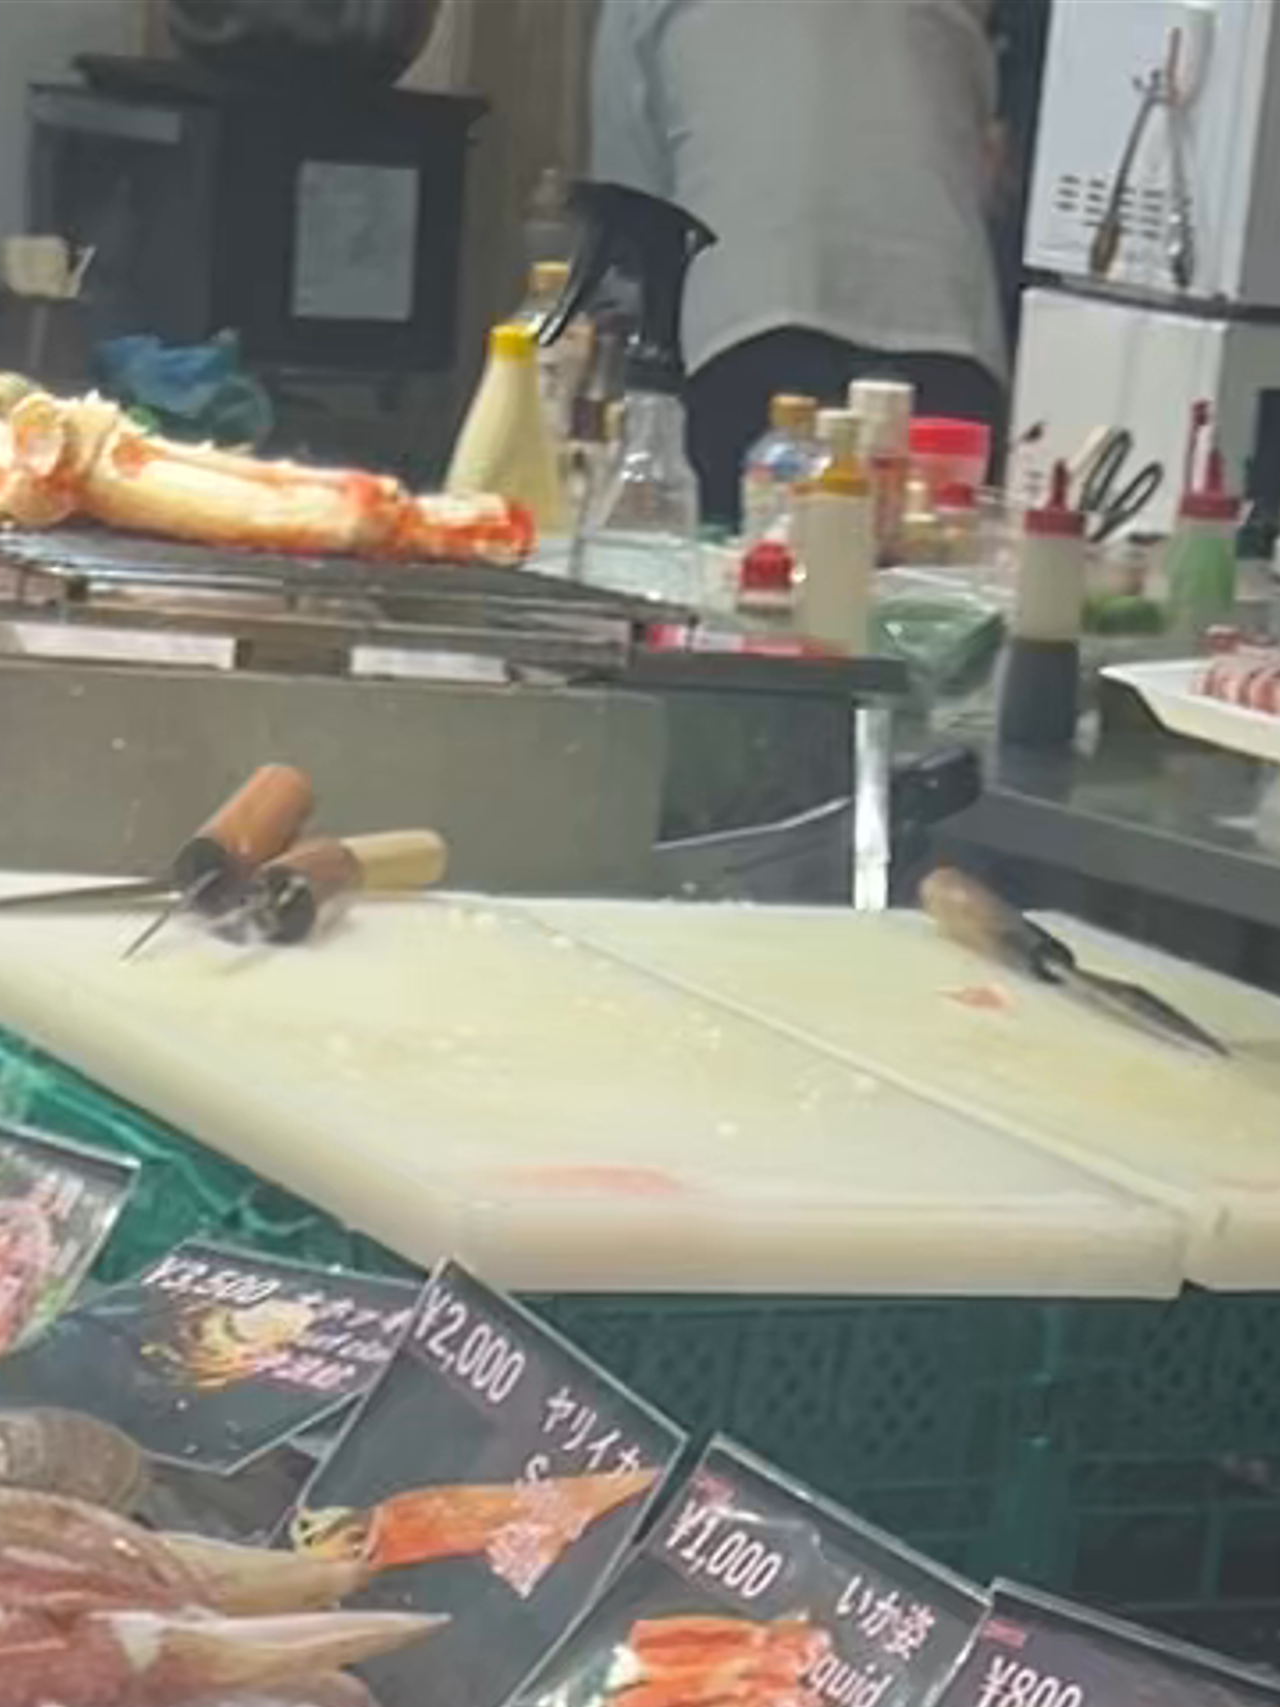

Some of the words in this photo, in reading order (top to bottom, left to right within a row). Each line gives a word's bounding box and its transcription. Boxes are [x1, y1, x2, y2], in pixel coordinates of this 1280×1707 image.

[414, 1286, 526, 1404] ¥2,000
[542, 1386, 640, 1478] ヤリイカ
[665, 1500, 783, 1599] ¥1,000
